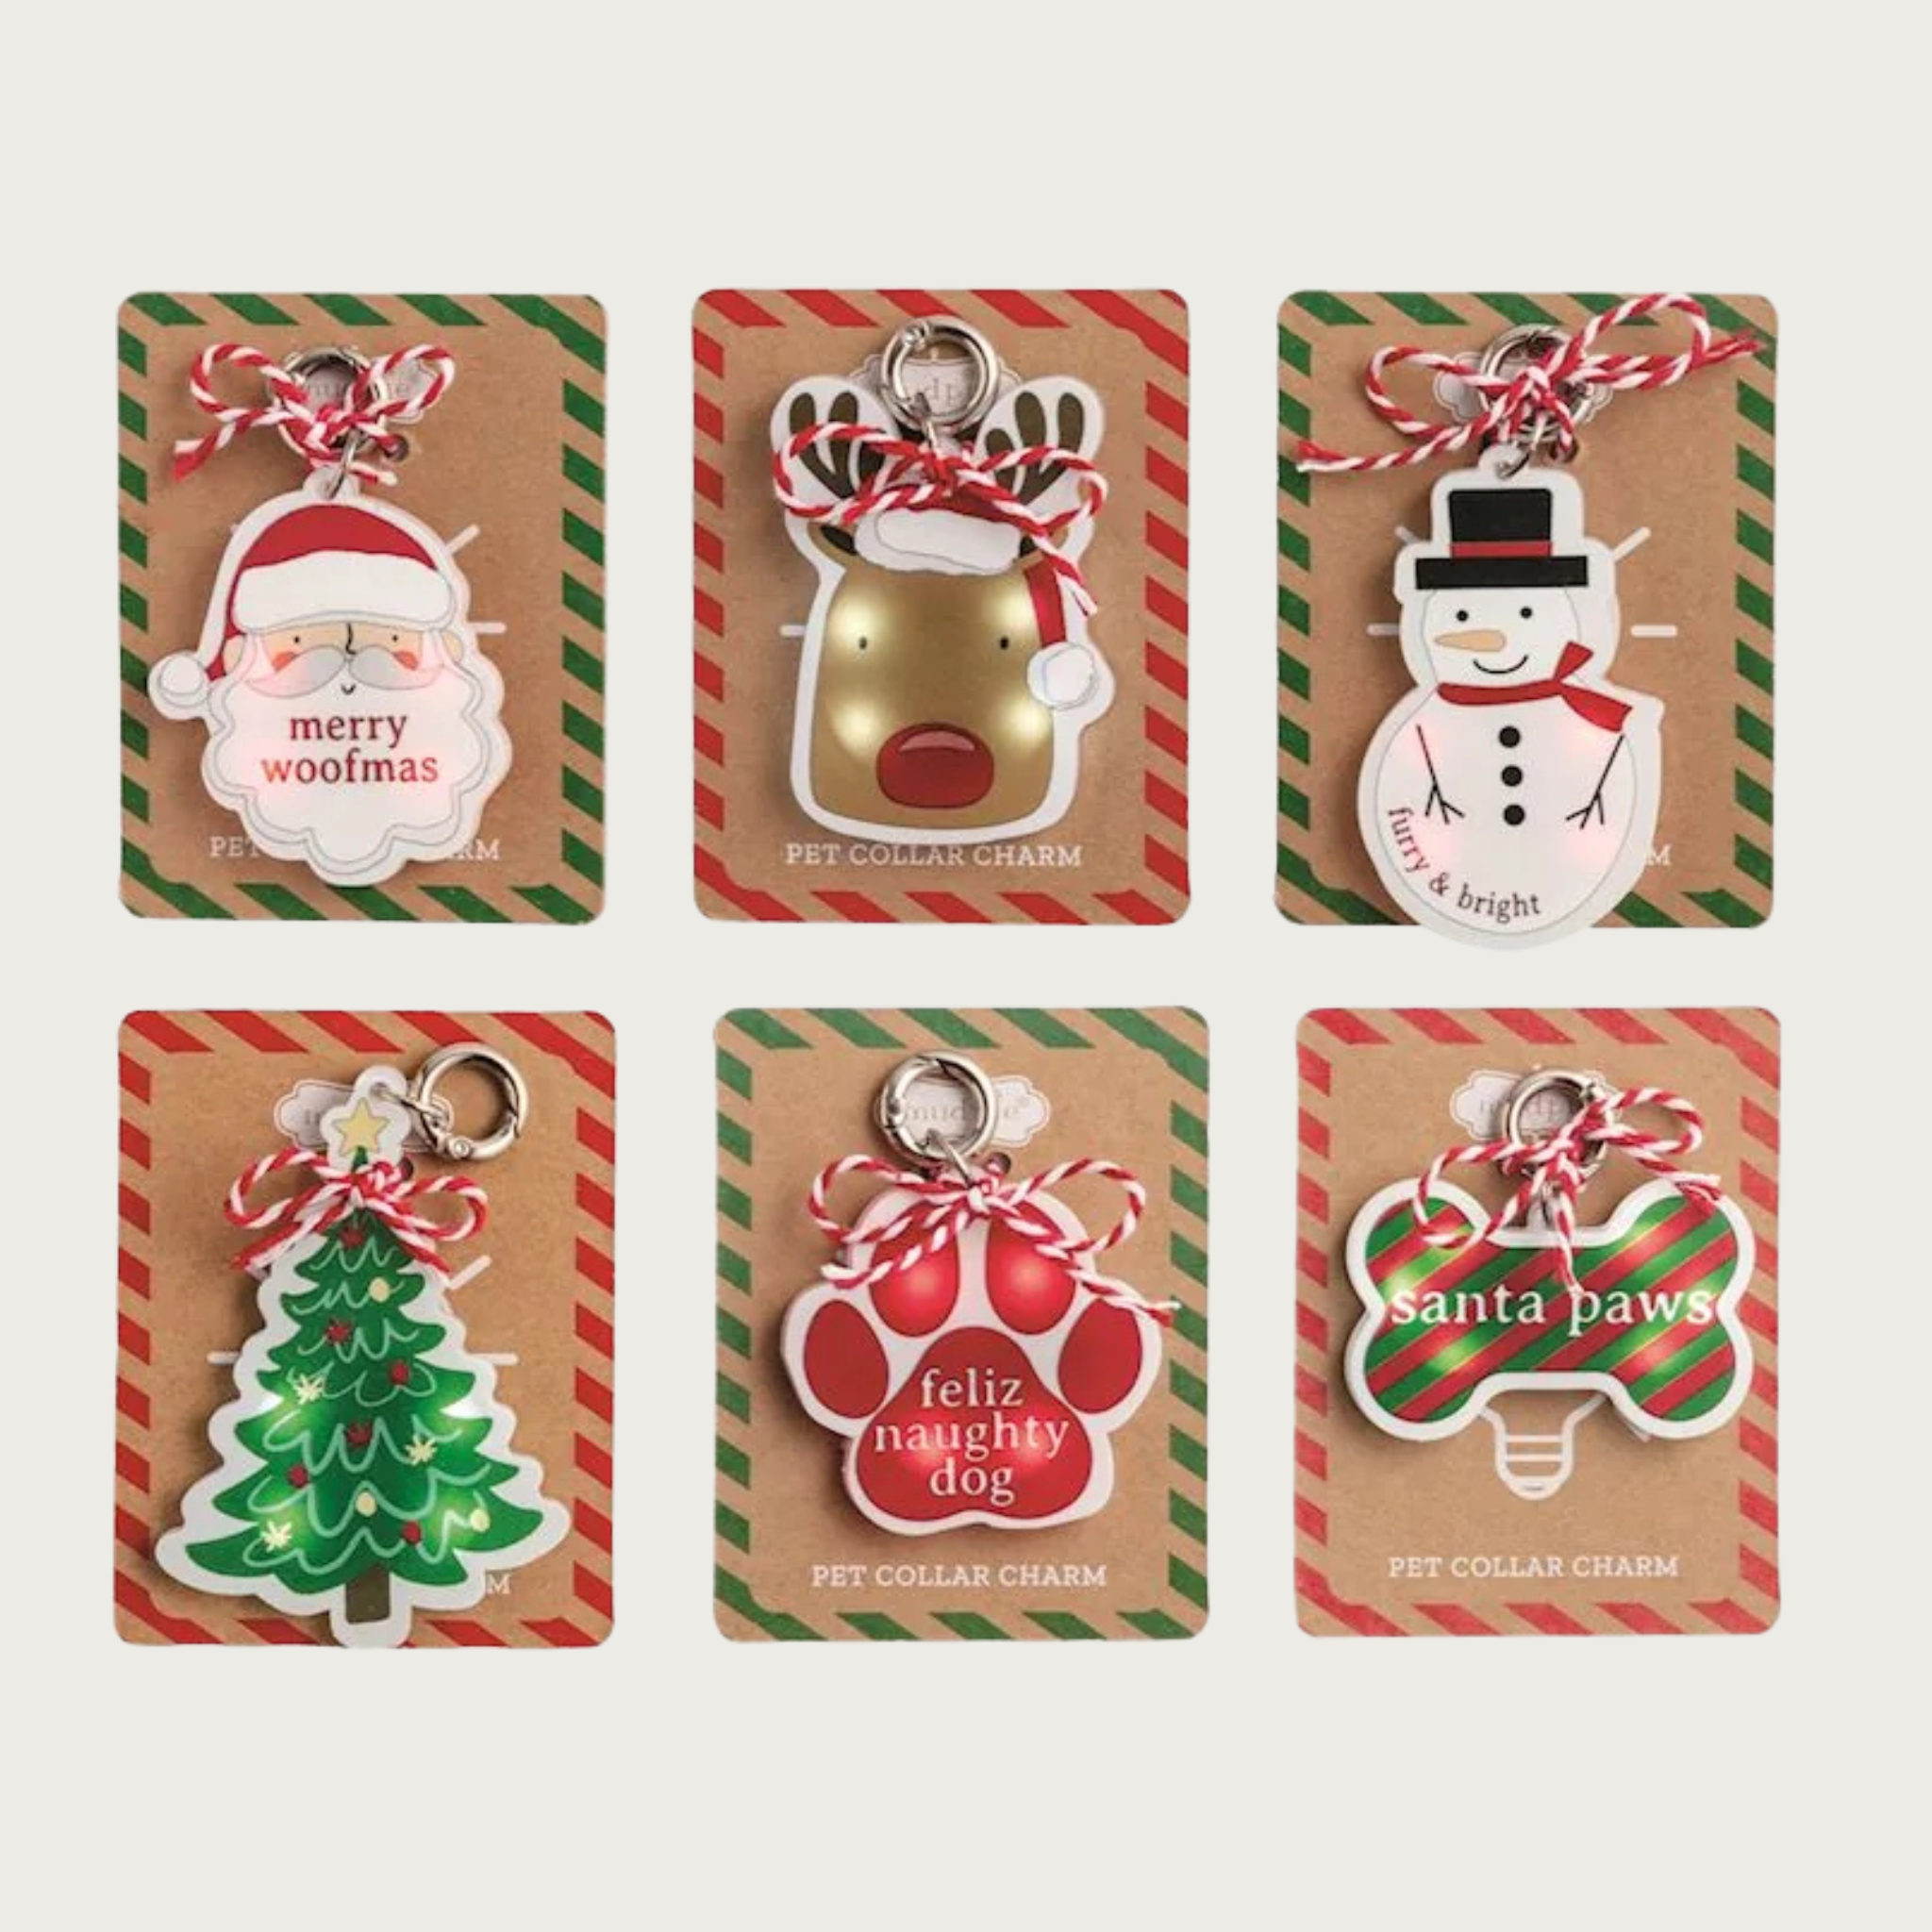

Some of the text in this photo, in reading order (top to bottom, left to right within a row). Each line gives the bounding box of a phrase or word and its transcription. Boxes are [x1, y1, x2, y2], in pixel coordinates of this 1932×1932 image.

[289, 714, 408, 749] merry
[260, 746, 439, 785] woofmas
[786, 843, 1083, 867] PET COLLAR CHARM
[1388, 807, 1541, 924] furry & bright
[1391, 1284, 1715, 1337] santa paws
[921, 1367, 1024, 1407] feliz
[874, 1410, 1070, 1462] naughty
[929, 1456, 1015, 1507] dog
[811, 1564, 1108, 1587] PET COLLAR CHARM
[1388, 1557, 1679, 1577] PET COLLAR CHARM
